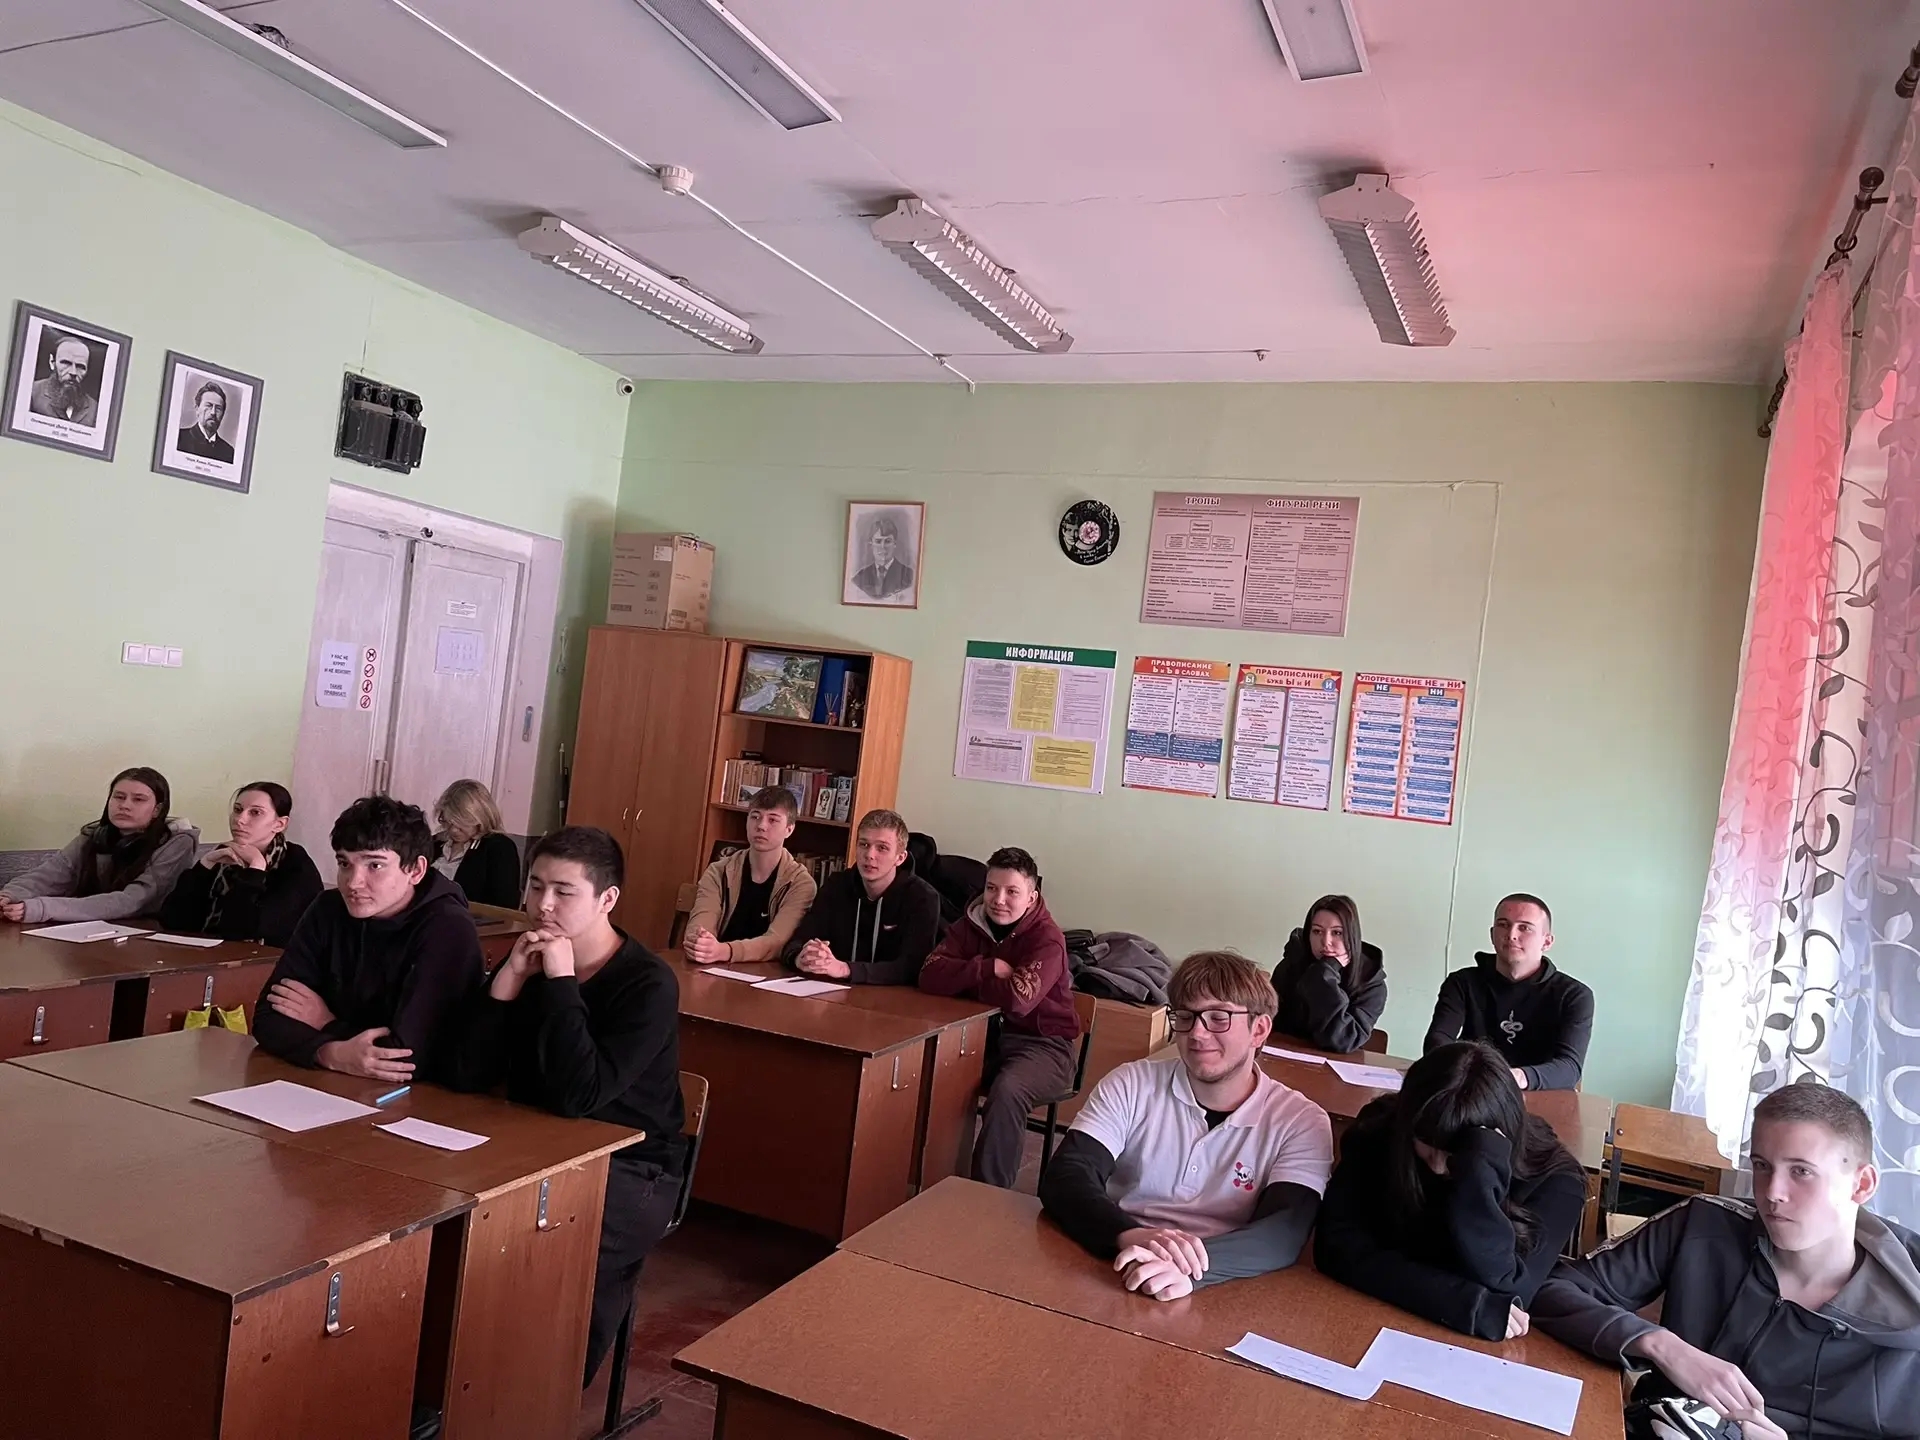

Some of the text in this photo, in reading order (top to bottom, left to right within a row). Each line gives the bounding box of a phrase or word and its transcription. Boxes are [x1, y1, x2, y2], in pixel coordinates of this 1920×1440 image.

[1185, 496, 1220, 506] ТРОПЫ
[1266, 498, 1340, 510] ФИГУРЫ РЕЧИ
[1005, 647, 1074, 662] ИНФОРМАЦИЯ
[1151, 659, 1212, 669] ПРАВОПИСАНИЕ
[1255, 668, 1324, 679] ПРАВОПИСАНИЕ
[1245, 675, 1255, 684] Ы
[1360, 675, 1422, 685] УПОТРЕБЛЕНИЕ
[1425, 679, 1438, 687] НЕ
[1325, 681, 1333, 689] И
